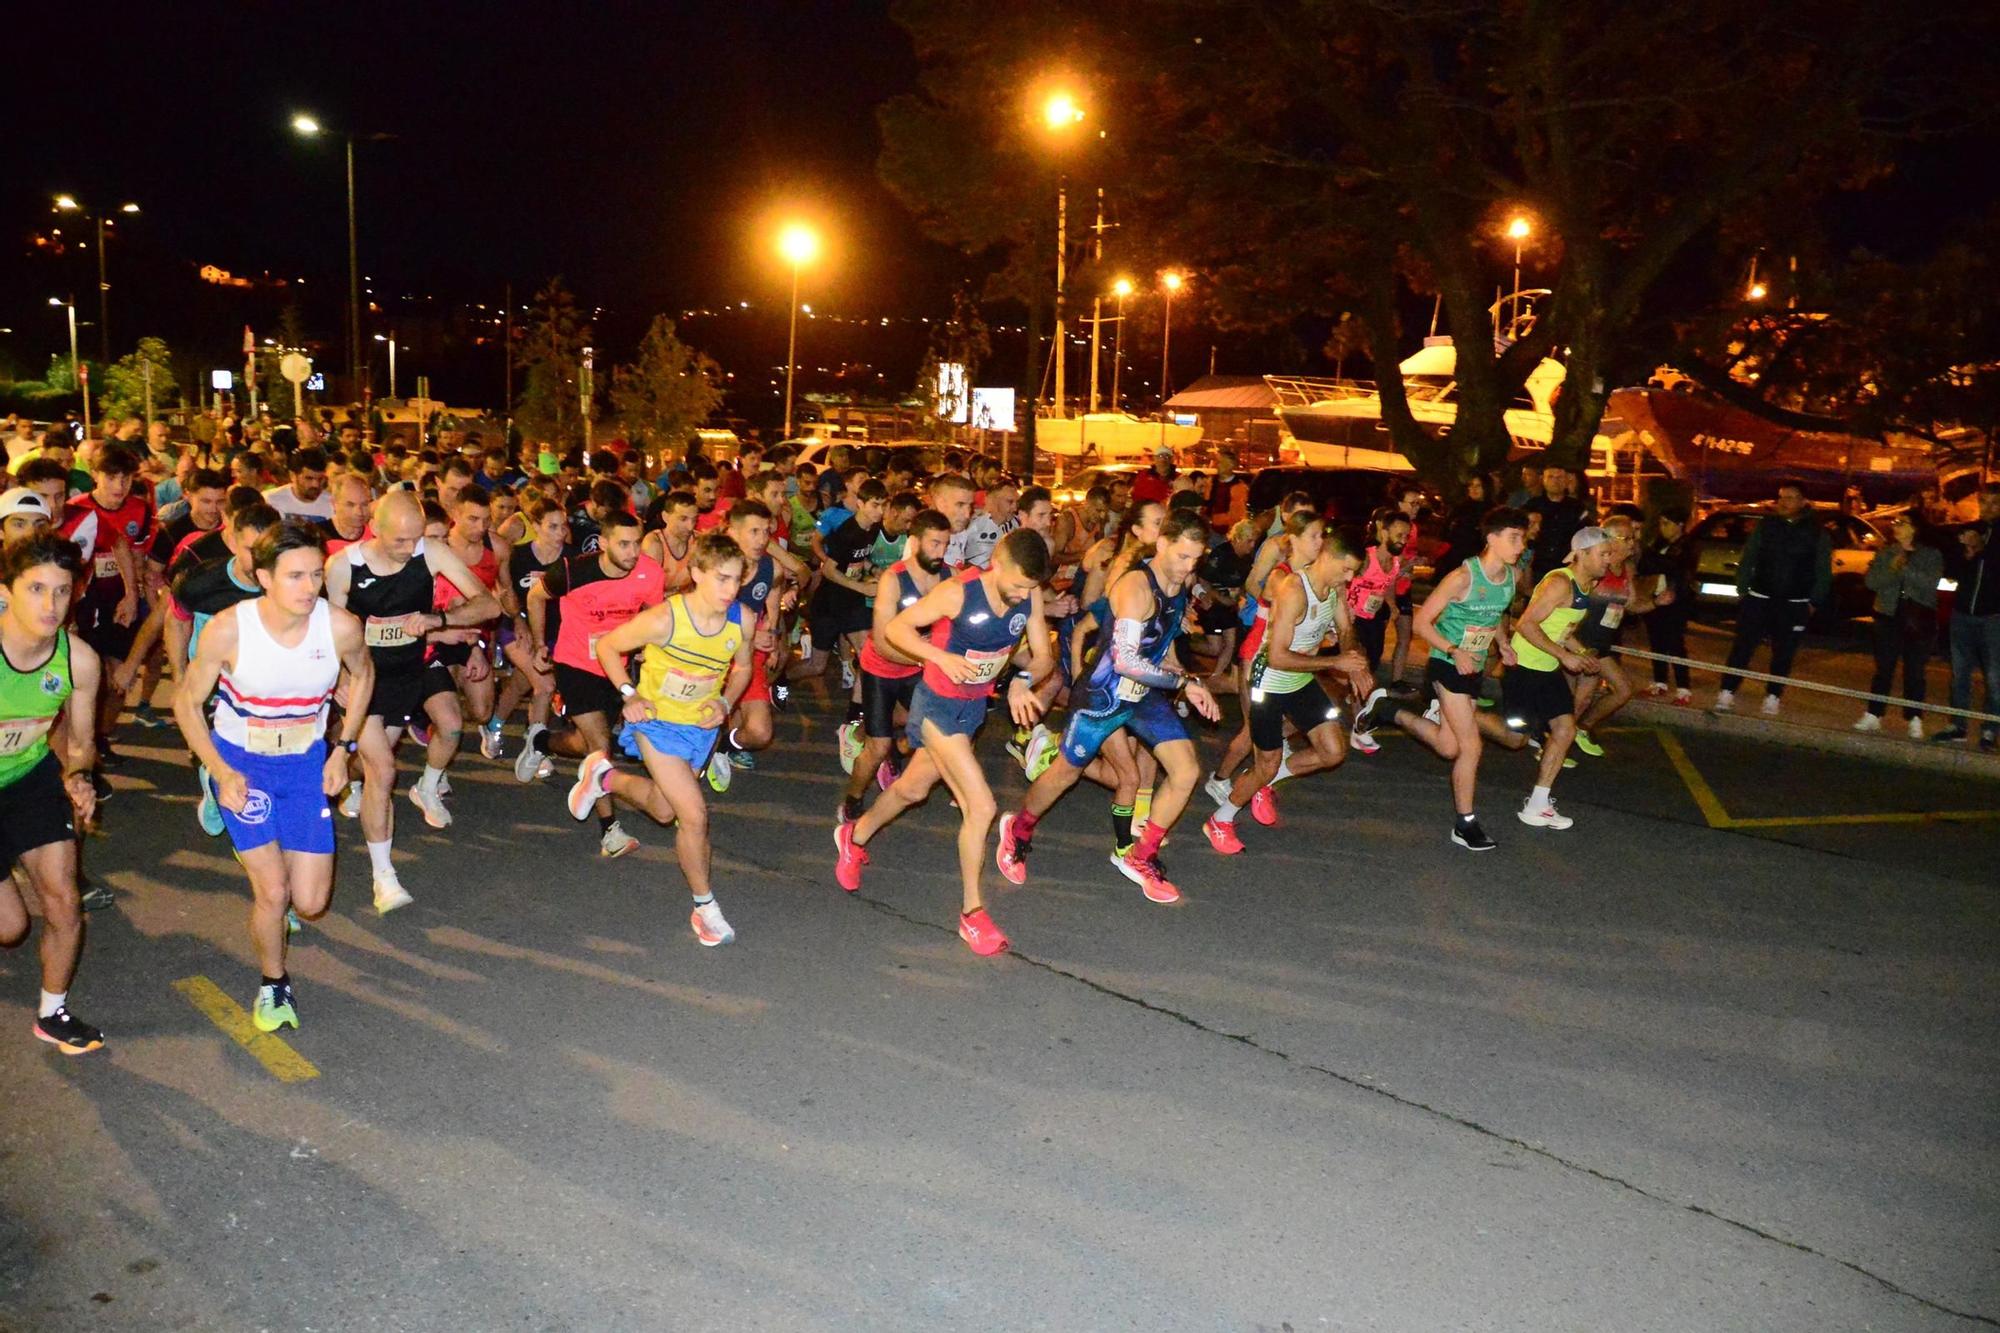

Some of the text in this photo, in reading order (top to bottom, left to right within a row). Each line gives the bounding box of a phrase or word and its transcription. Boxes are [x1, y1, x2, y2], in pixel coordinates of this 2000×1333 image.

[104, 560, 119, 572] 13
[380, 627, 403, 640] 130
[1471, 635, 1485, 646] 47
[681, 682, 697, 697] 12
[1130, 680, 1145, 695] 13
[4, 732, 23, 748] 71
[277, 733, 283, 748] 1
